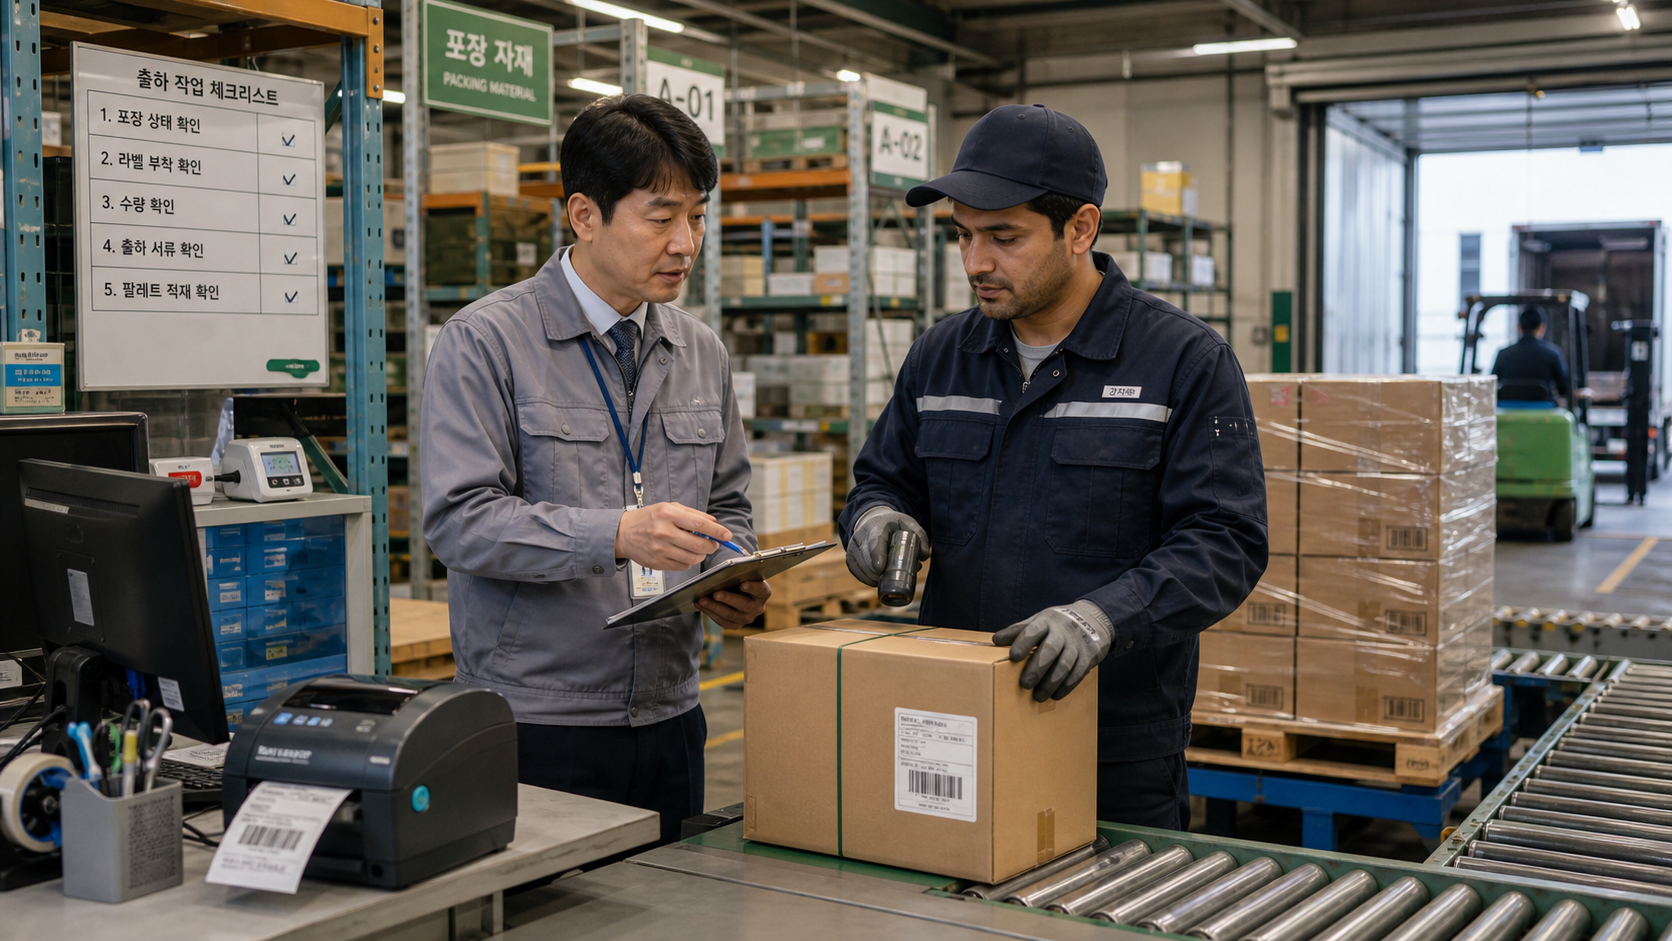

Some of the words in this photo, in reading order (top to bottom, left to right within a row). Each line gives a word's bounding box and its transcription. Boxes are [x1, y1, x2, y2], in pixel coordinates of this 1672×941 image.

[445, 28, 488, 68] 포장
[493, 39, 534, 78] 자재
[137, 68, 169, 91] 출하
[175, 75, 203, 96] 작업
[210, 81, 278, 105] 체크리스트
[443, 70, 488, 93] PACKING
[489, 80, 537, 103] MATERIAL
[659, 77, 714, 122] A-01
[101, 108, 111, 122] 1.
[118, 110, 143, 127] 포장
[148, 113, 171, 130] 상태
[177, 116, 200, 133] 확인
[877, 124, 923, 161] A-02
[102, 151, 112, 165] 2.
[119, 153, 143, 170] 라벨
[149, 156, 173, 172] 부착
[178, 158, 200, 175] 확인
[103, 195, 113, 209] 3.
[120, 196, 145, 212] 수량
[151, 198, 174, 214] 확인
[103, 239, 115, 253] 4.
[121, 239, 146, 255] 출하
[152, 241, 175, 257] 서류
[181, 242, 203, 258] 확인
[105, 283, 116, 296] 5.
[123, 282, 162, 298] 팔레트
[167, 284, 190, 299] 적재
[196, 284, 218, 300] 확인
